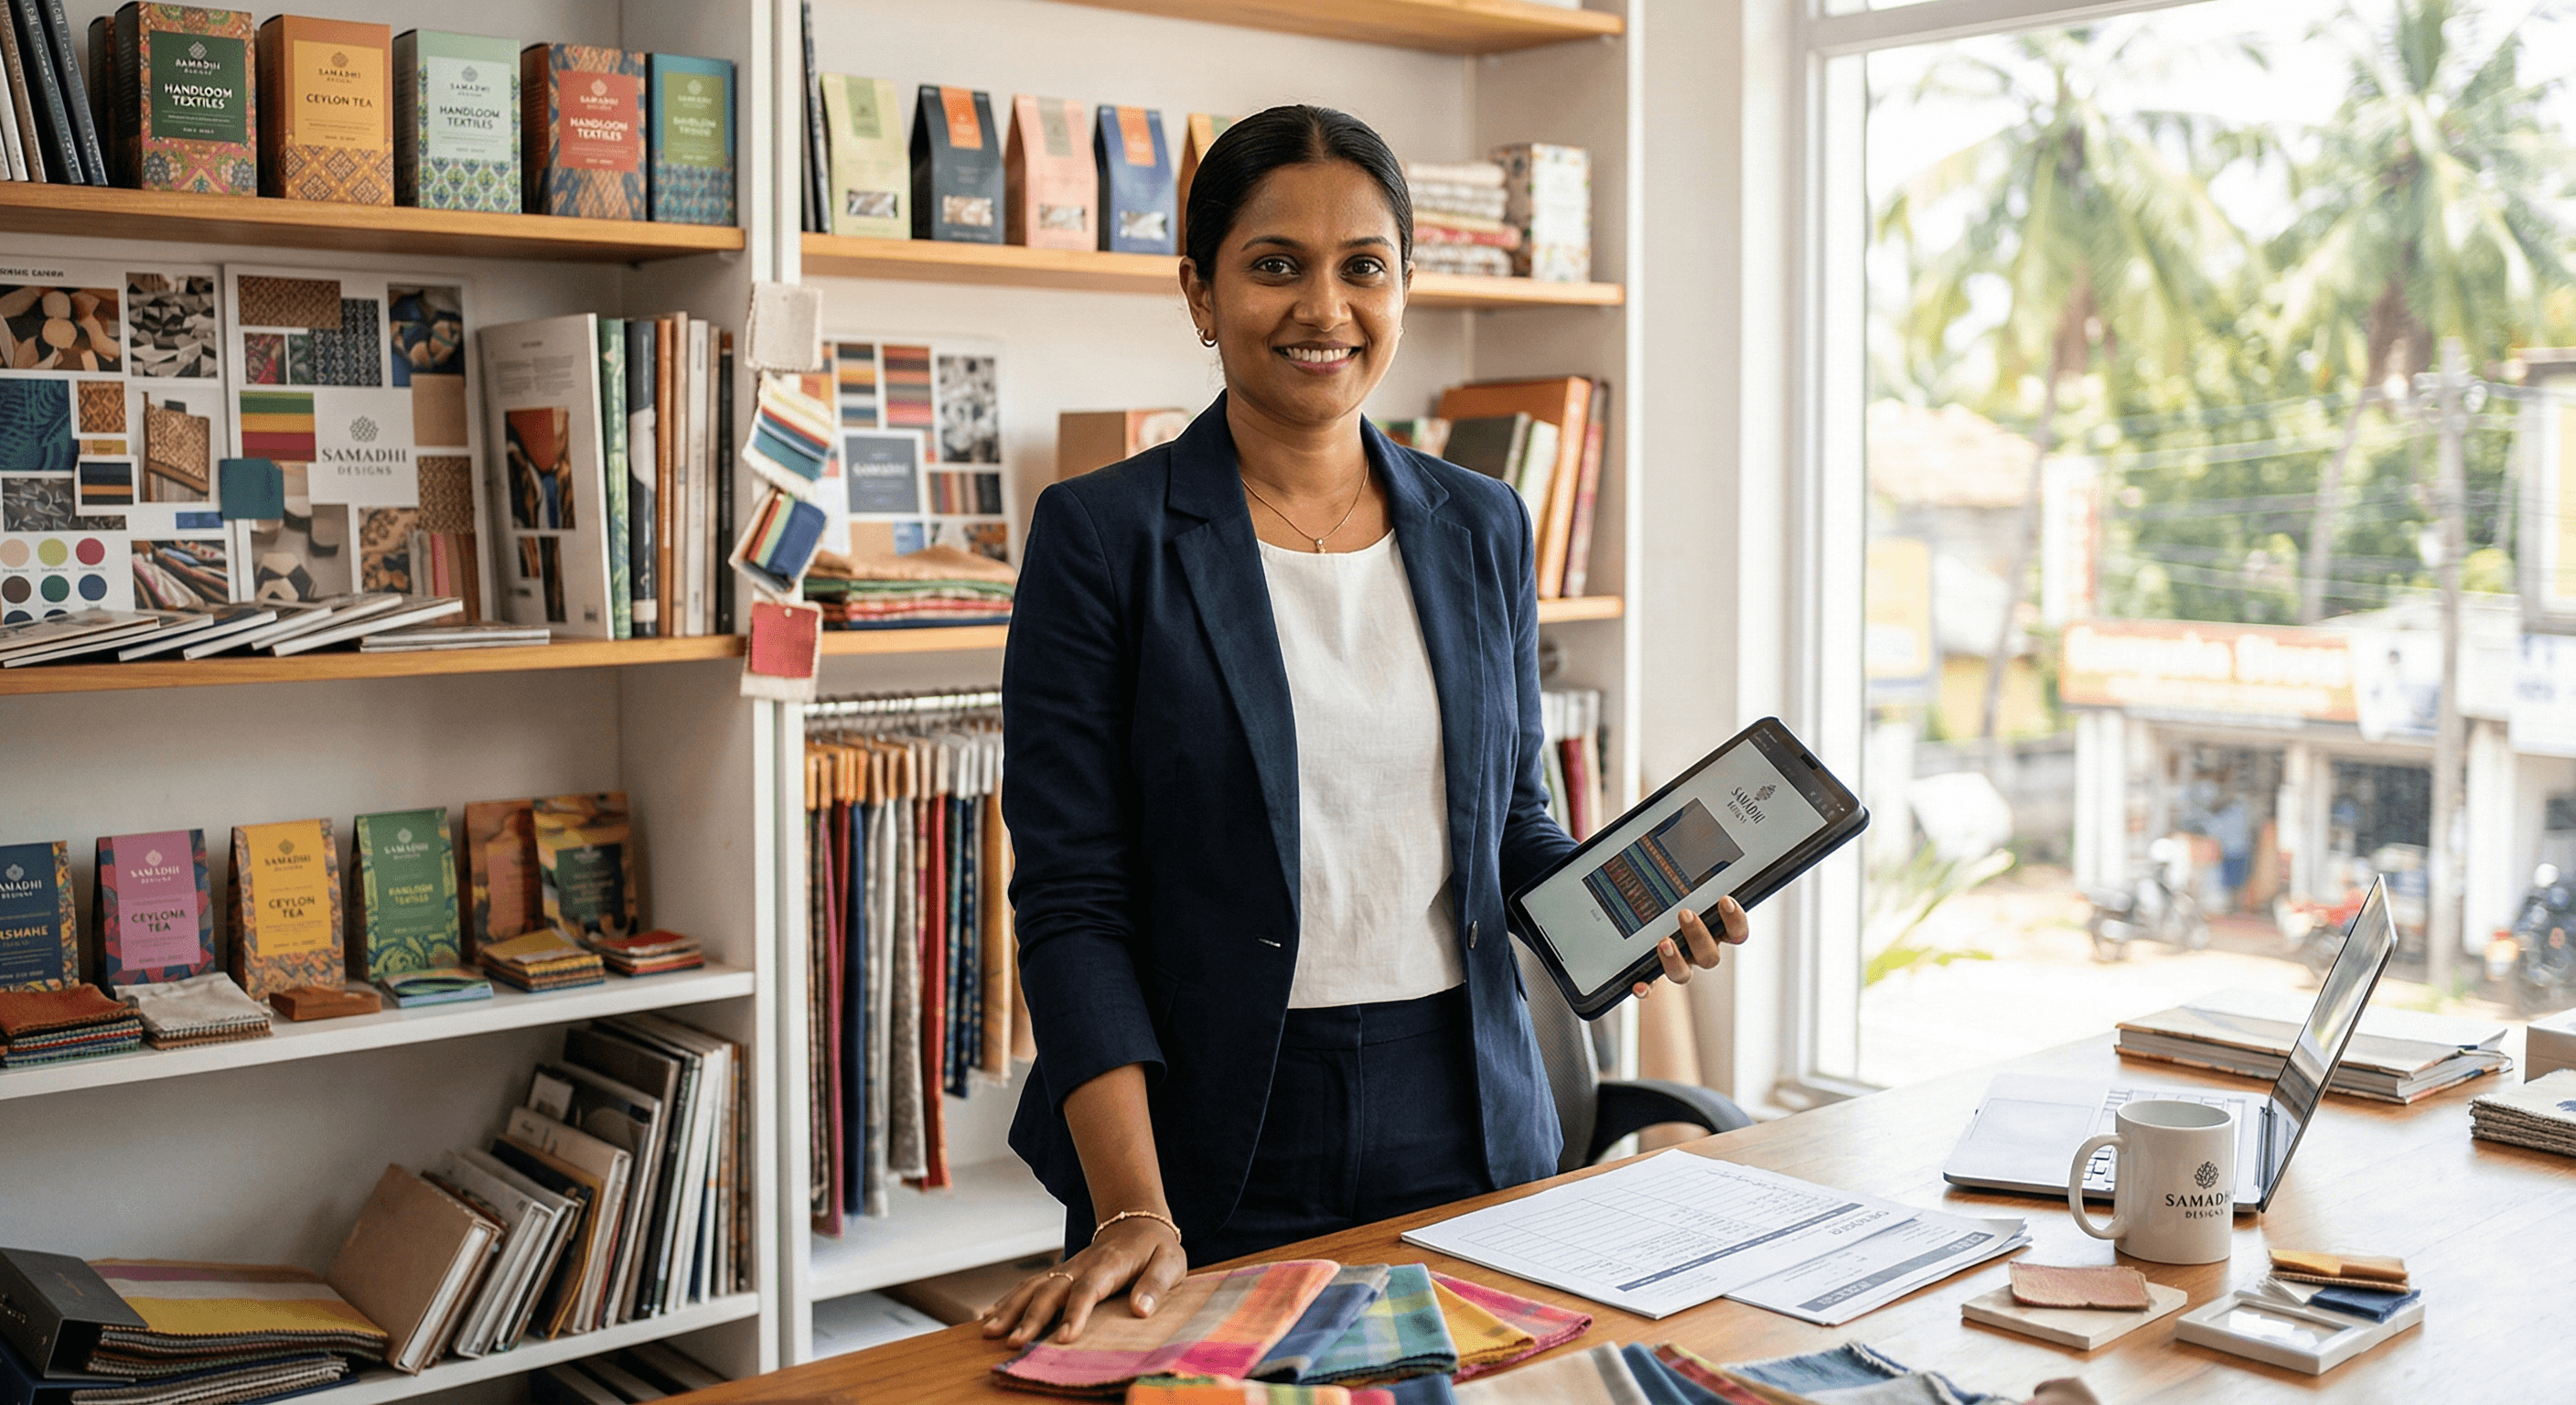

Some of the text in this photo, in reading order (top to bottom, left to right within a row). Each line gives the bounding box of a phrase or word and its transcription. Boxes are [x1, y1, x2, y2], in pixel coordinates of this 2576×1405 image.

[165, 83, 232, 99] HANDLOOM
[172, 95, 225, 109] TEXTILES
[306, 93, 372, 108] CEYLON TEA
[439, 106, 500, 119] HANDLOOM
[447, 117, 493, 130] TEXTILES
[322, 447, 406, 463] SAMADHI
[337, 465, 392, 476] DESIGNS
[268, 896, 316, 909] CEYLON
[282, 908, 305, 918] TEA
[148, 922, 171, 933] TEA
[2165, 1190, 2231, 1207] SAMADH
